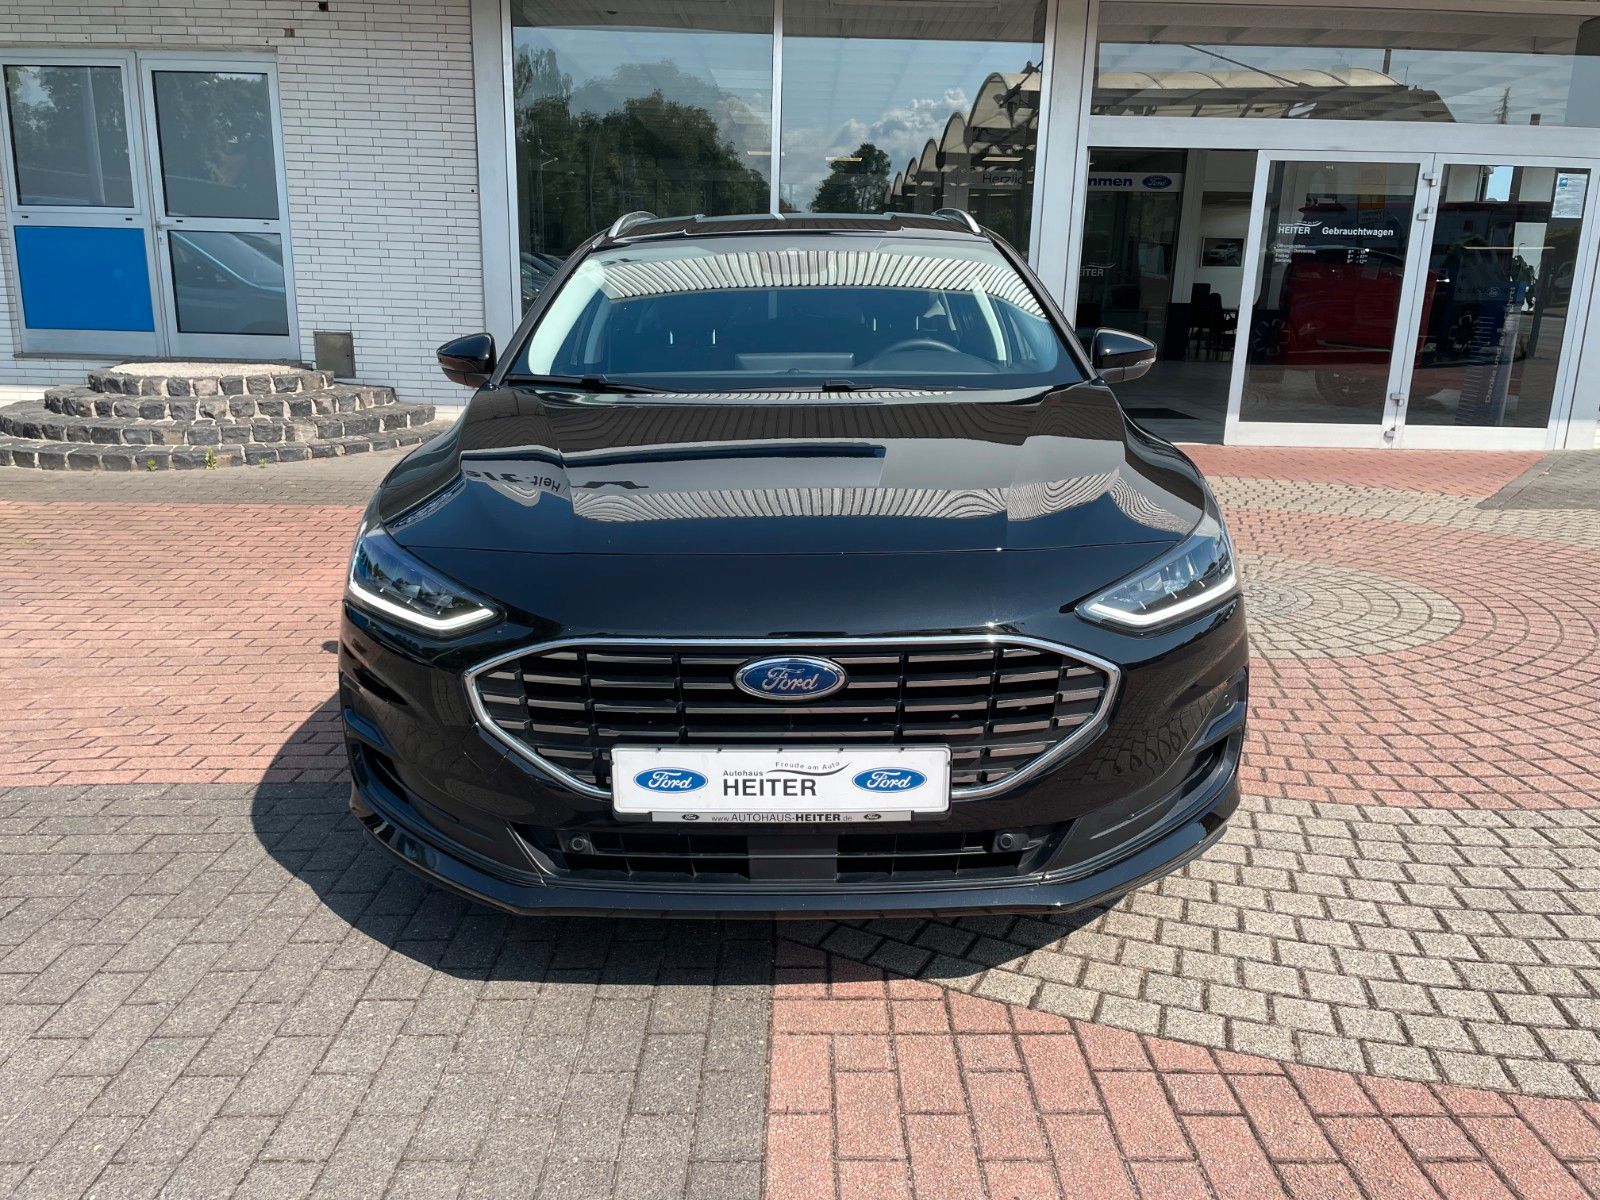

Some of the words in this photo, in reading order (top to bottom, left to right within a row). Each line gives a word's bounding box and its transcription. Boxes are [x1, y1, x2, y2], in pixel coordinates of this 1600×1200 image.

[1277, 226, 1311, 235] HEITER
[1322, 227, 1394, 238] Gebrauchtwagen
[762, 665, 819, 692] Ford
[775, 761, 806, 769] Freude
[821, 761, 841, 771] Auto
[722, 769, 764, 777] Autohaus
[648, 770, 694, 790] Ford
[867, 770, 912, 790] Ford
[723, 778, 817, 797] HEITER
[711, 813, 853, 823] www.AUTOHAUS-HEITER.de
